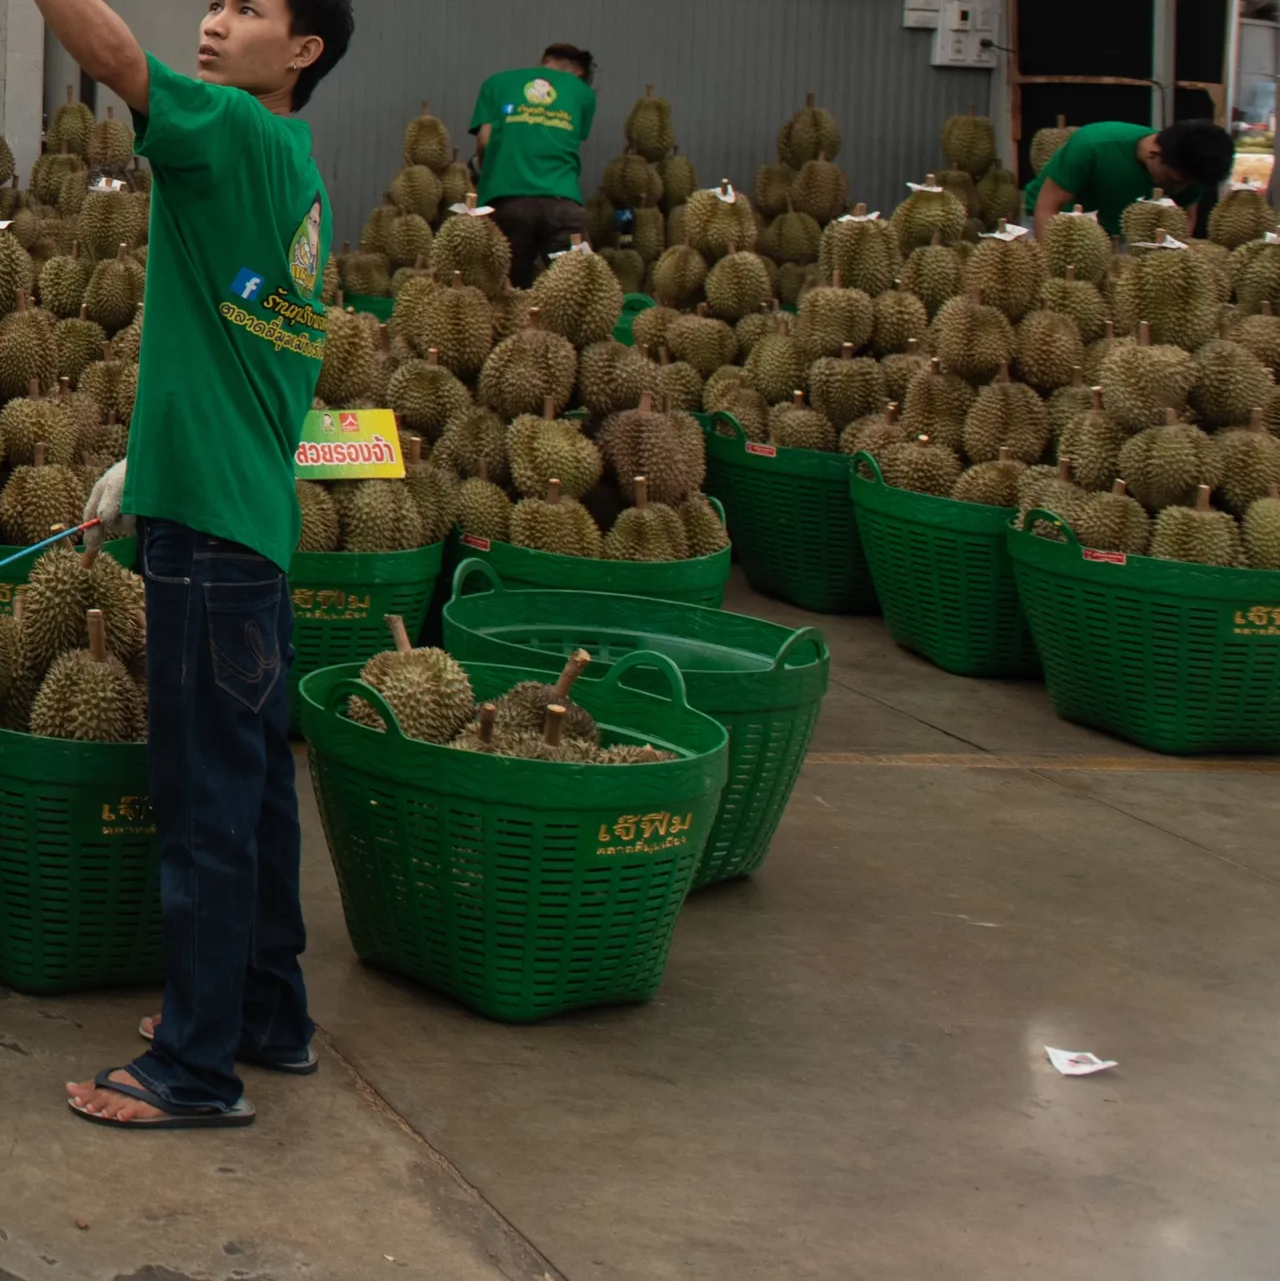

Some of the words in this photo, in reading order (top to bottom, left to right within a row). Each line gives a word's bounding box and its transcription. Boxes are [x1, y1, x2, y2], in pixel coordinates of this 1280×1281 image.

[295, 435, 395, 464] สวยรองจ้า
[290, 588, 371, 609] จ๊ฟีม
[598, 810, 693, 842] เจ๊ฟีม
